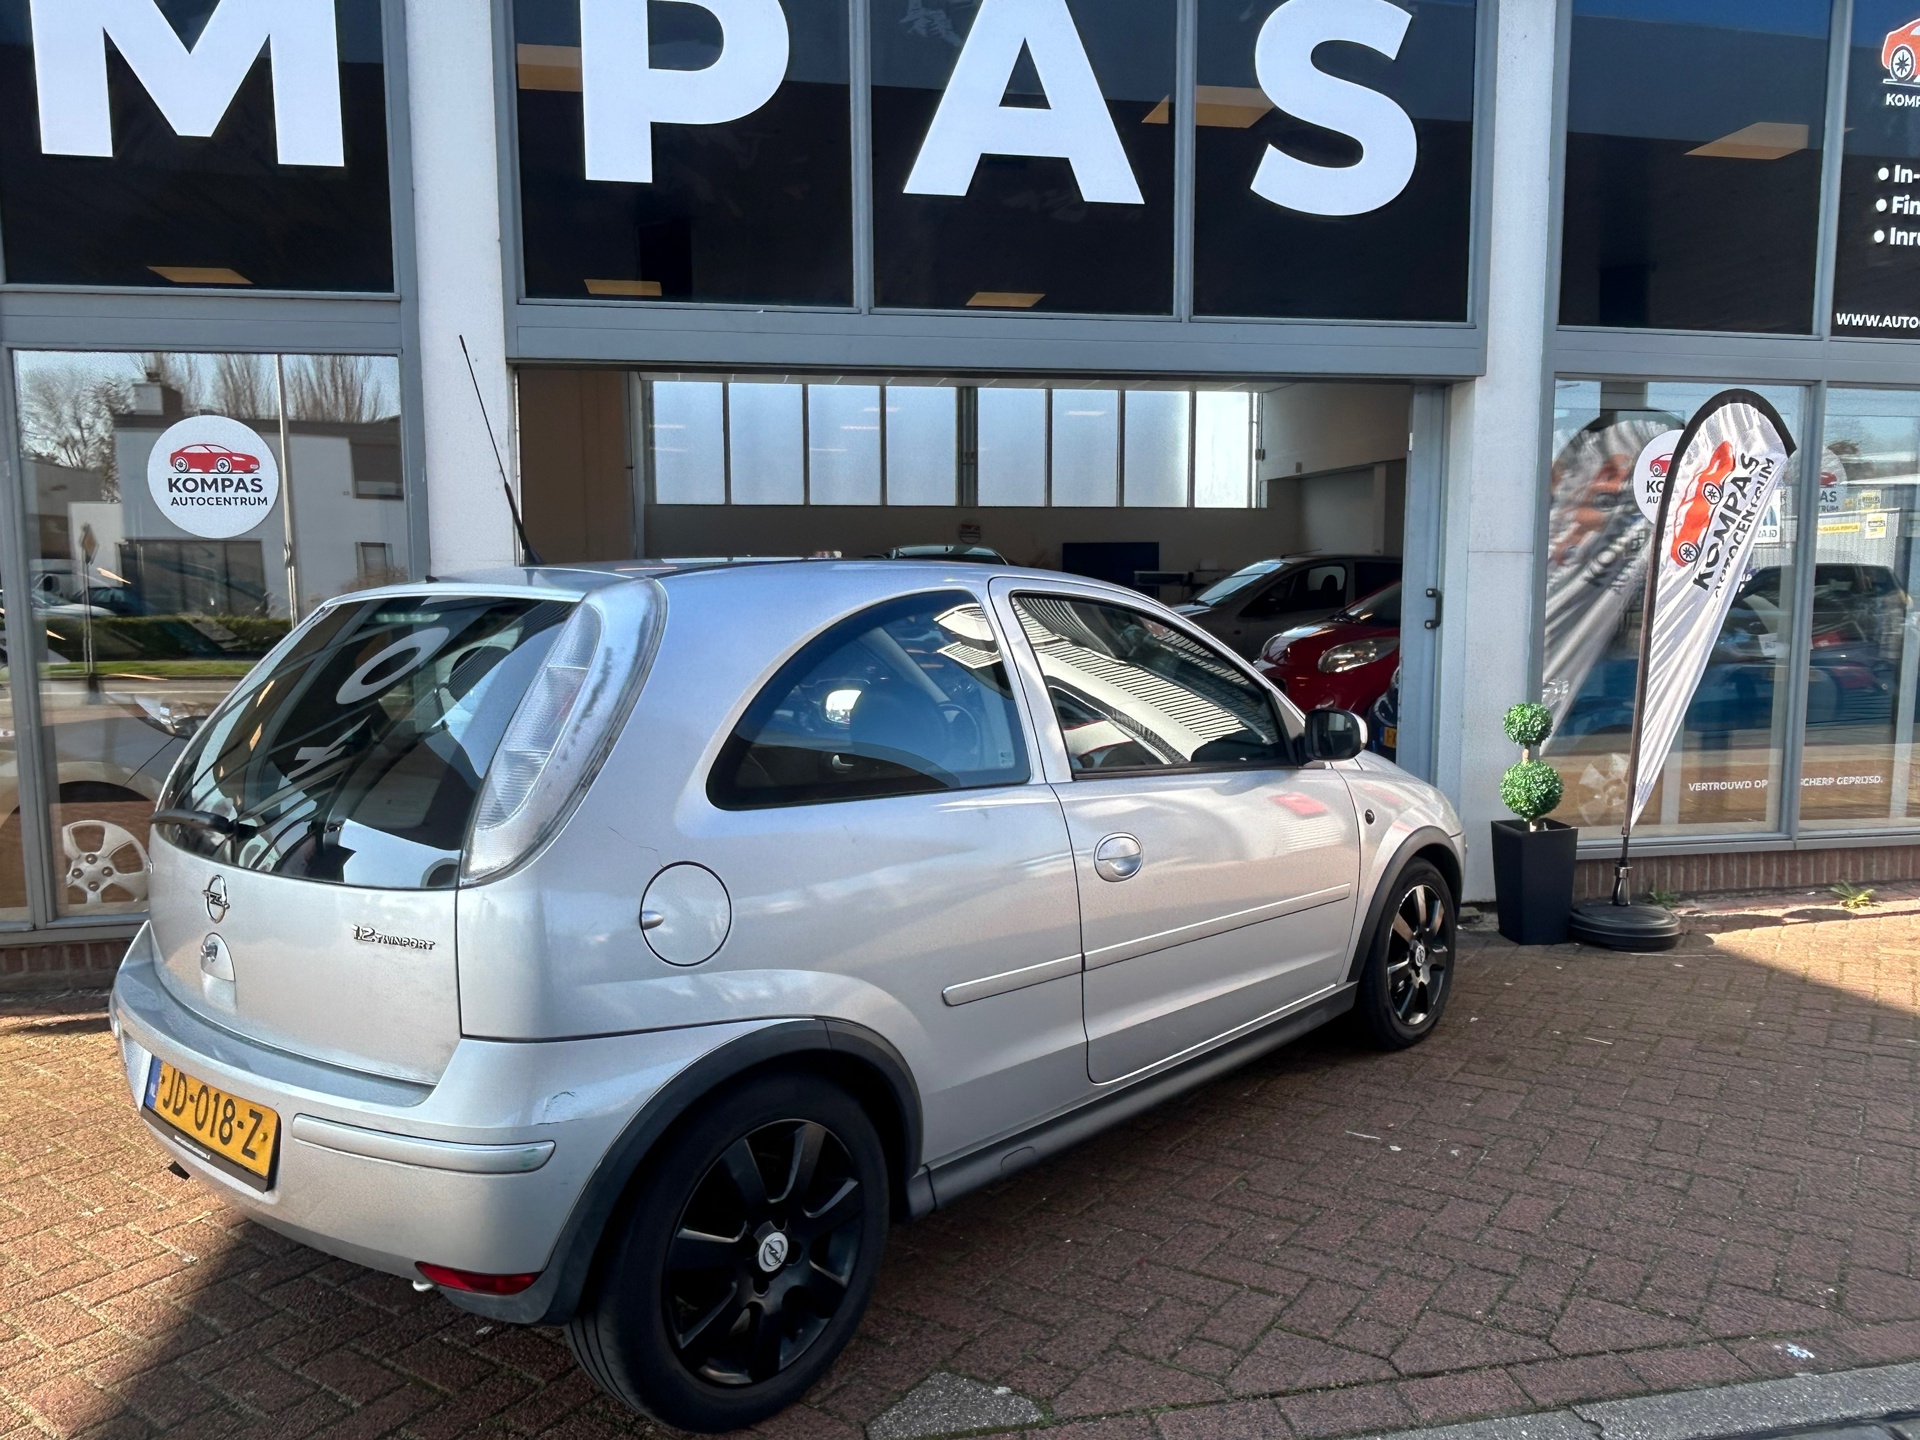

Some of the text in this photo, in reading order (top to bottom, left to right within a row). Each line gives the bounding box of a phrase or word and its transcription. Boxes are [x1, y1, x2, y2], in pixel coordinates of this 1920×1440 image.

[1836, 312, 1920, 329] WWW.AUTO
[167, 477, 264, 494] KOMPAS
[170, 496, 268, 507] AUTOCENTRUM
[1692, 452, 1760, 592] KOMPAS
[1688, 779, 1769, 792] VERTROUWD OP
[162, 1067, 264, 1161] JD-018-Z
